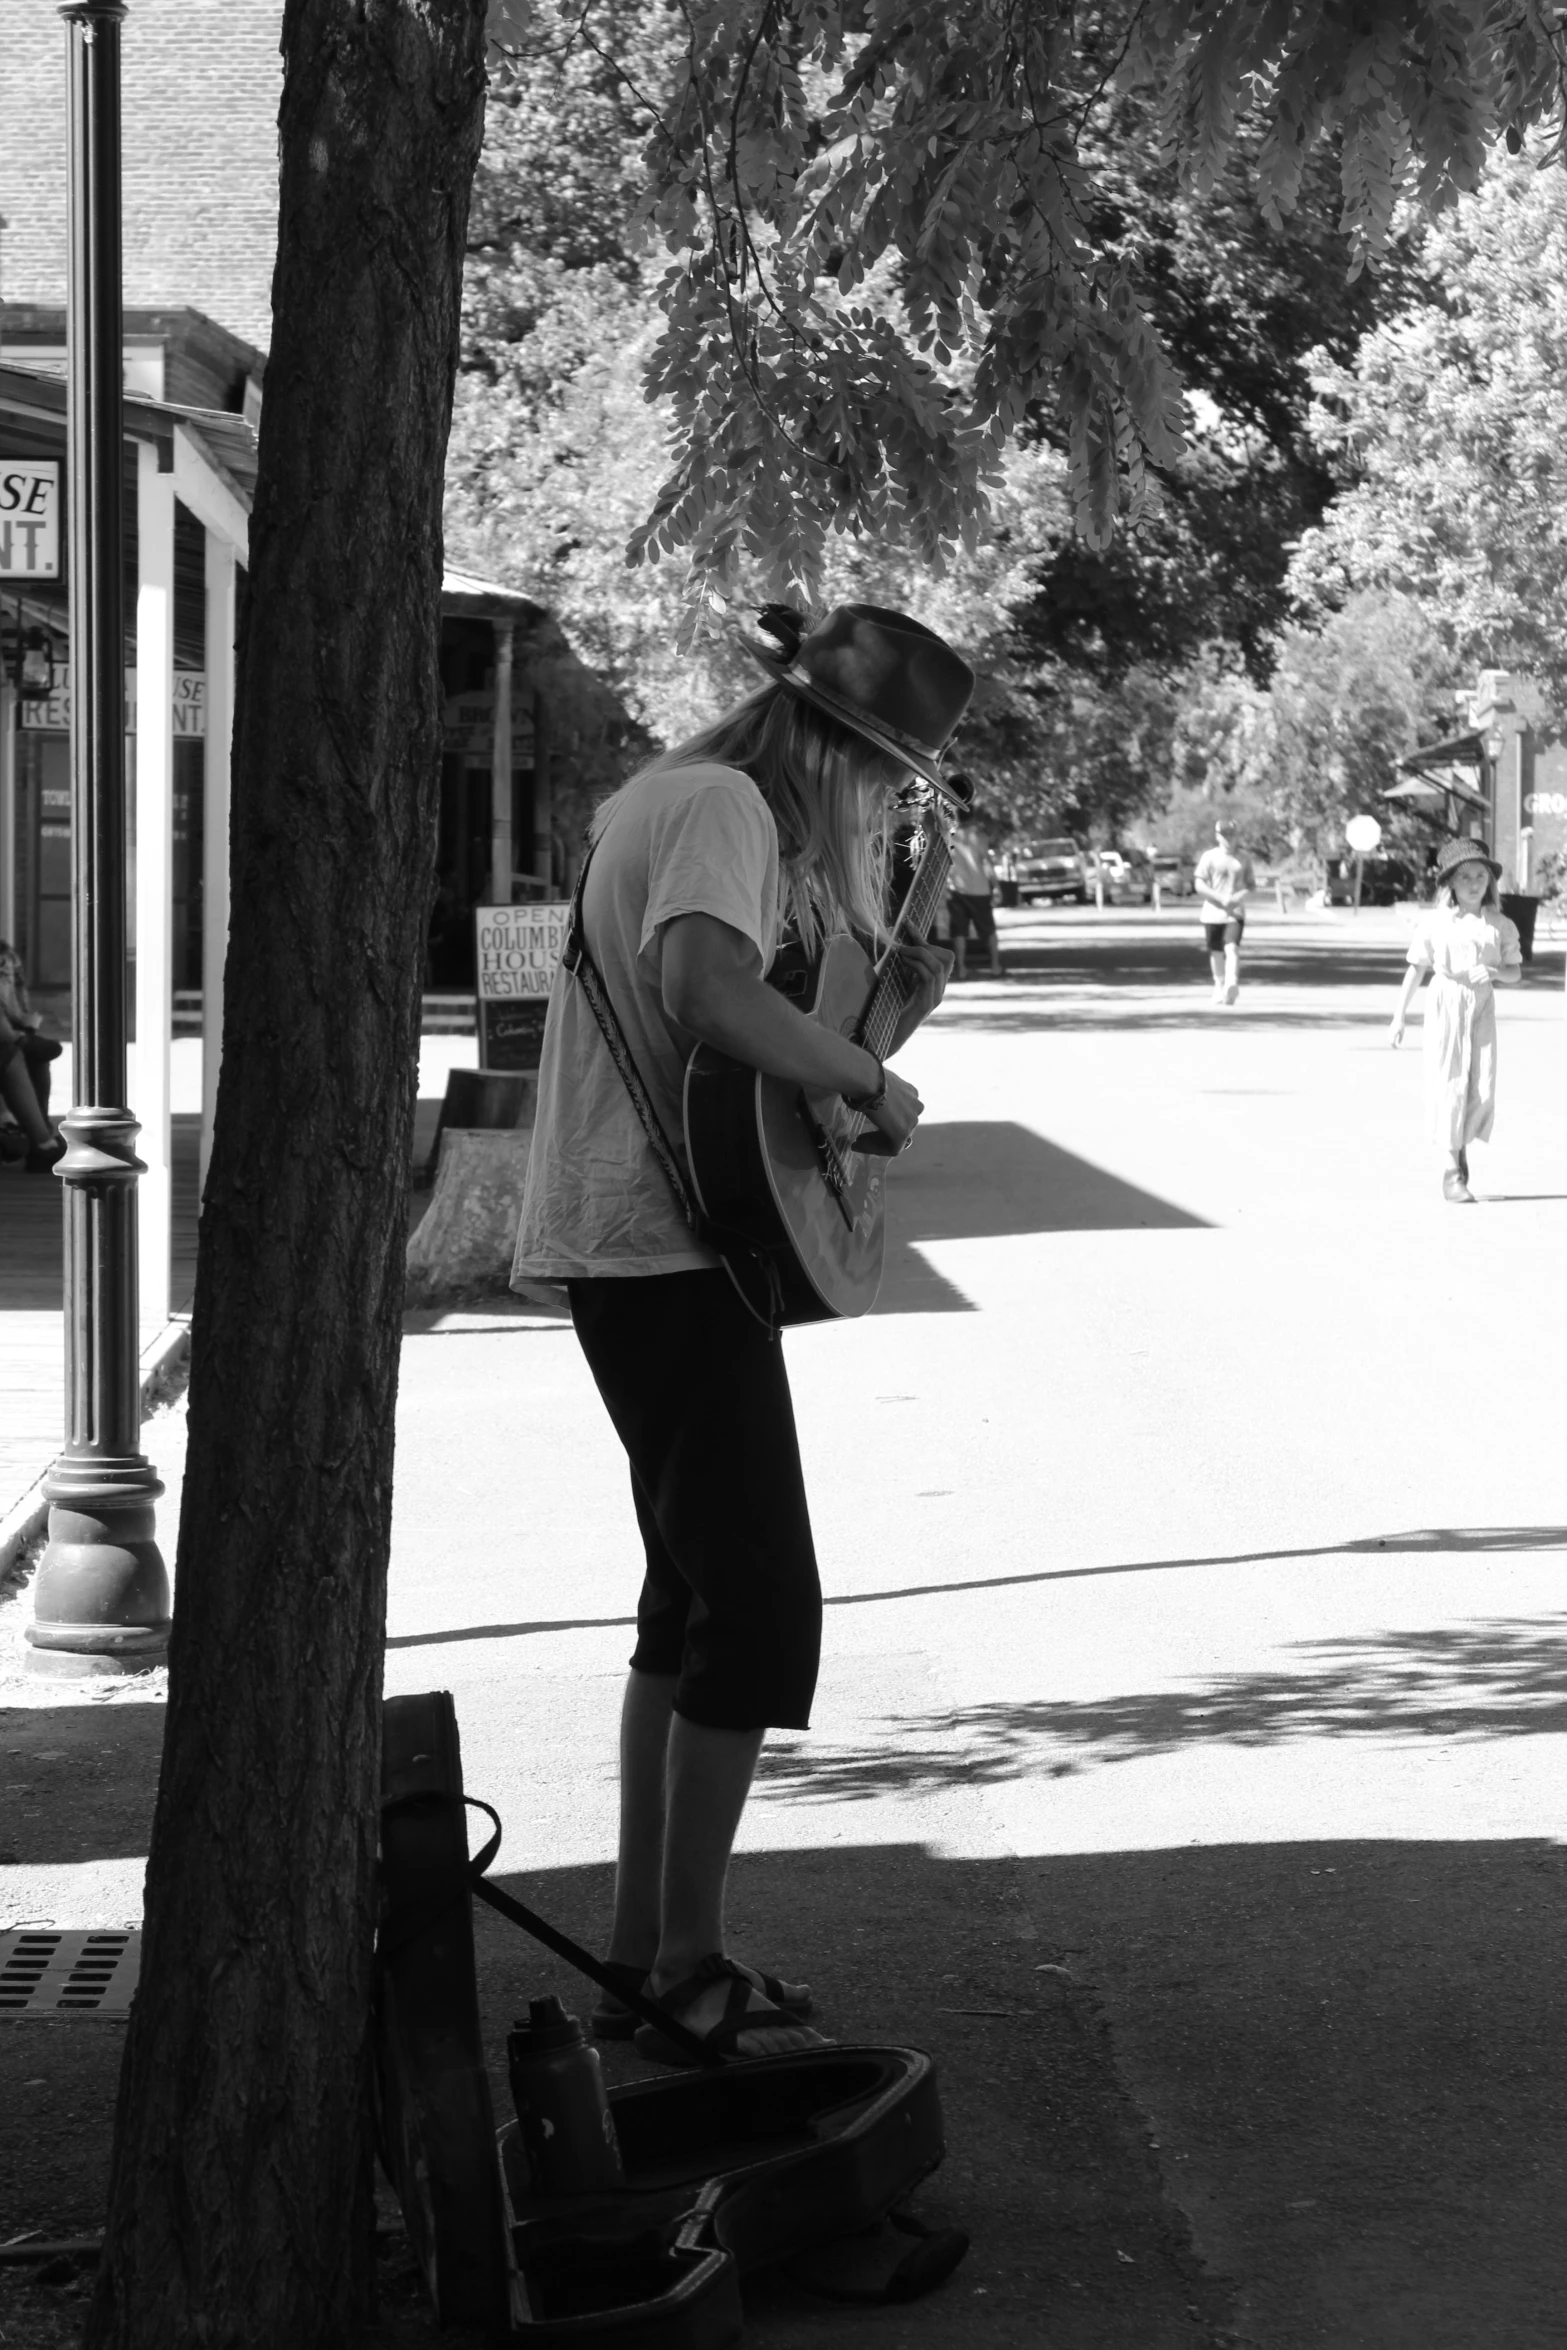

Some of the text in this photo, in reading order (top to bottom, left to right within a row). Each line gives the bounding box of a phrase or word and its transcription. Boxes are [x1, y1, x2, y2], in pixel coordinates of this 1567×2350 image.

[1523, 793, 1567, 814] GRO
[492, 908, 564, 926] OPEN
[483, 949, 558, 970] HOUS
